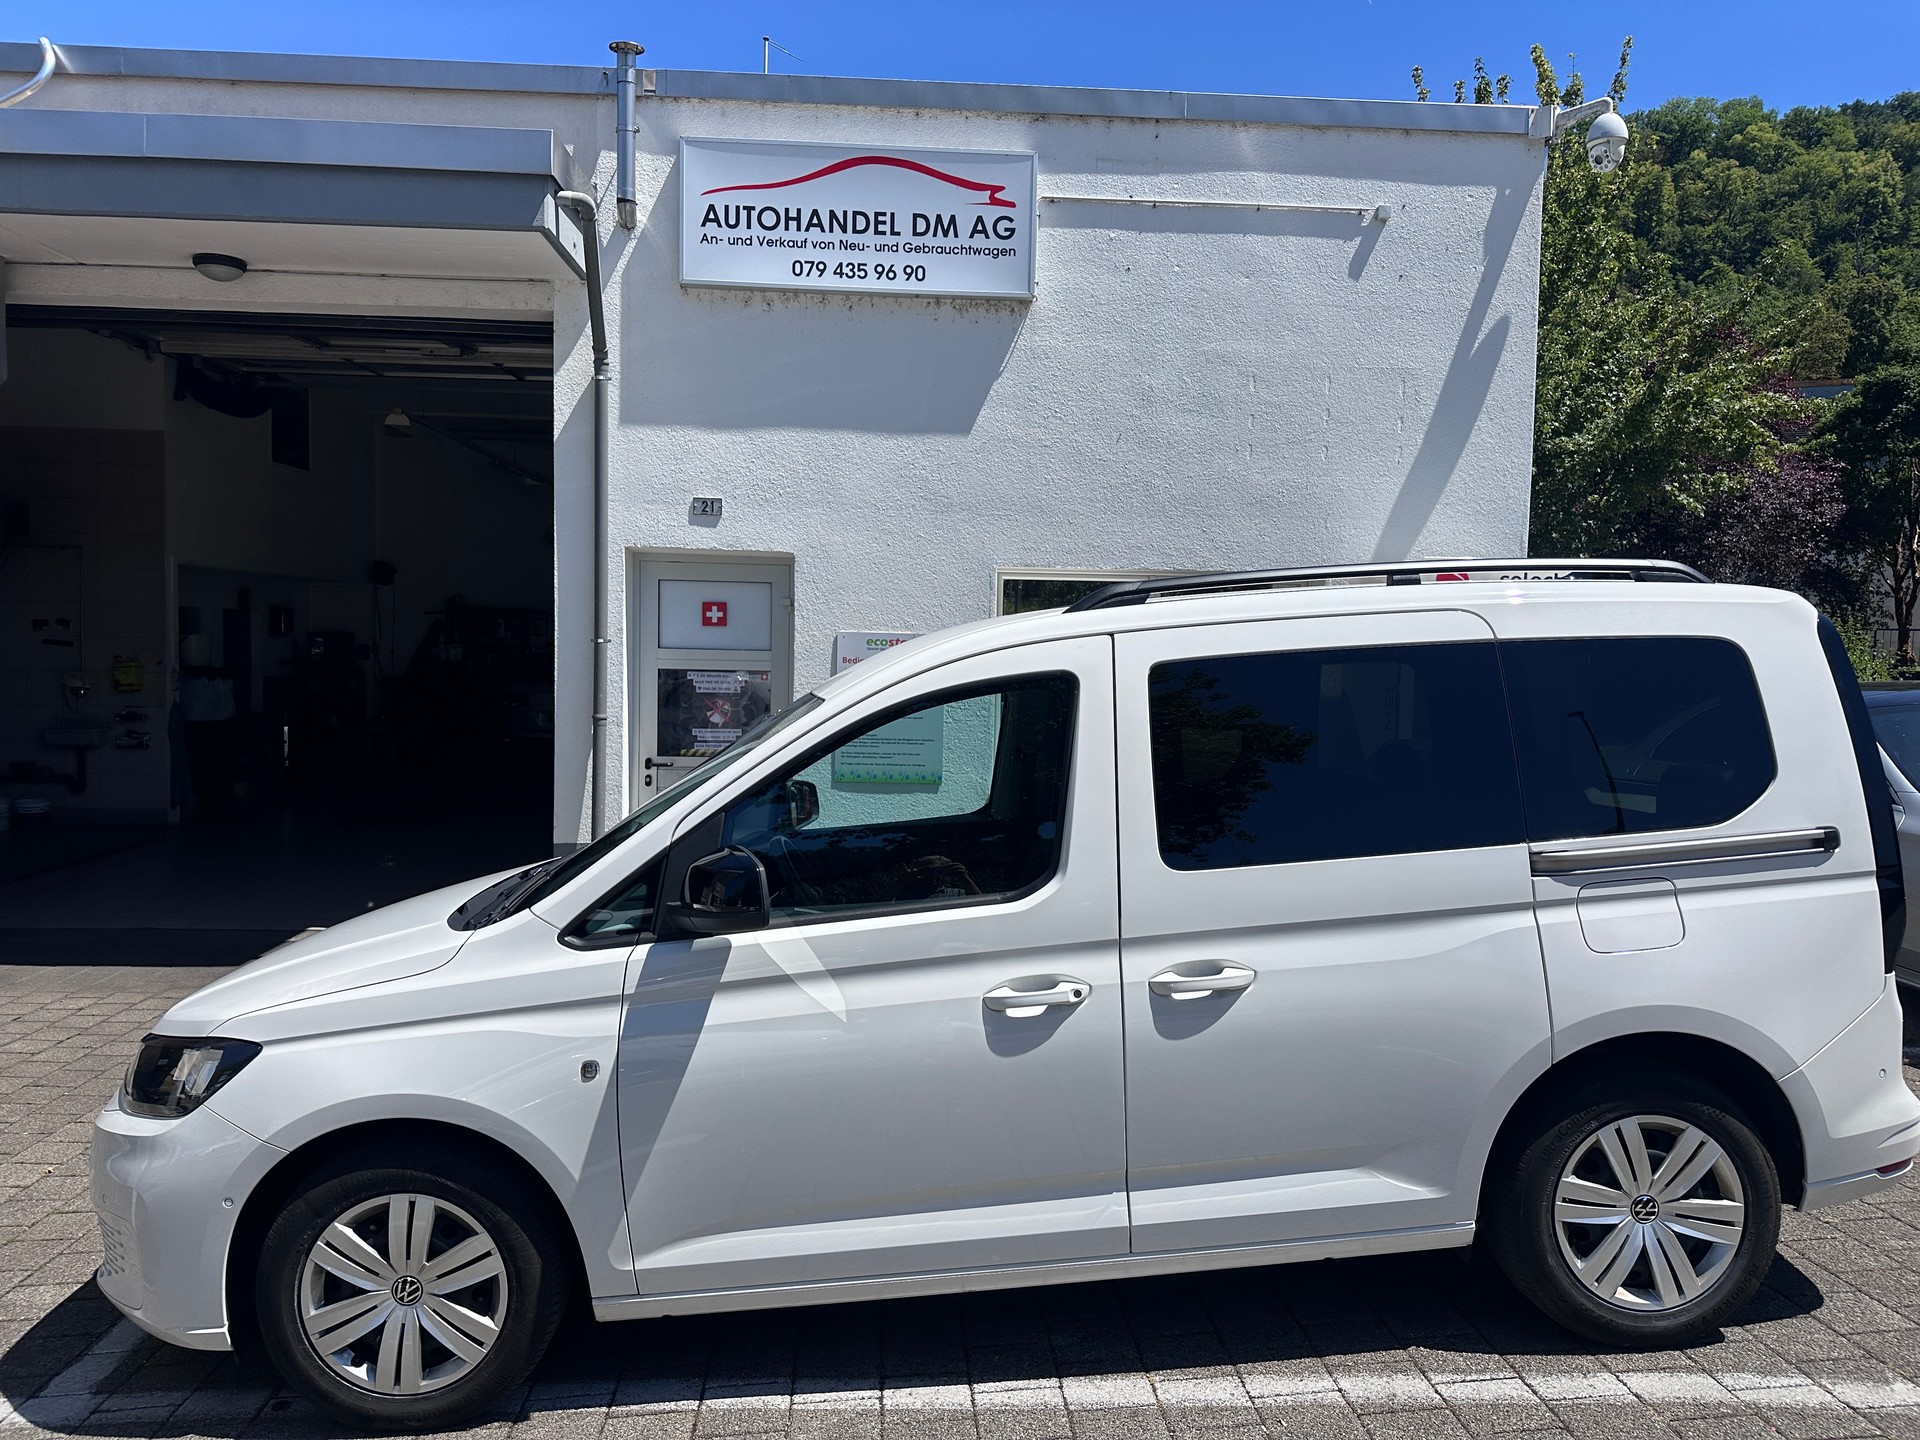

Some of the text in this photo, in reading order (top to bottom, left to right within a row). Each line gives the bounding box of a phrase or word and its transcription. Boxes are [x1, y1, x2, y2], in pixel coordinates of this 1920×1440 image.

[700, 203, 1017, 241] AUTOHANDEL DM AG
[699, 232, 1017, 260] An- und Verkauf von Neu- und Gebrauchtwagen
[791, 259, 927, 282] 079 435 96 90
[701, 500, 715, 513] 21
